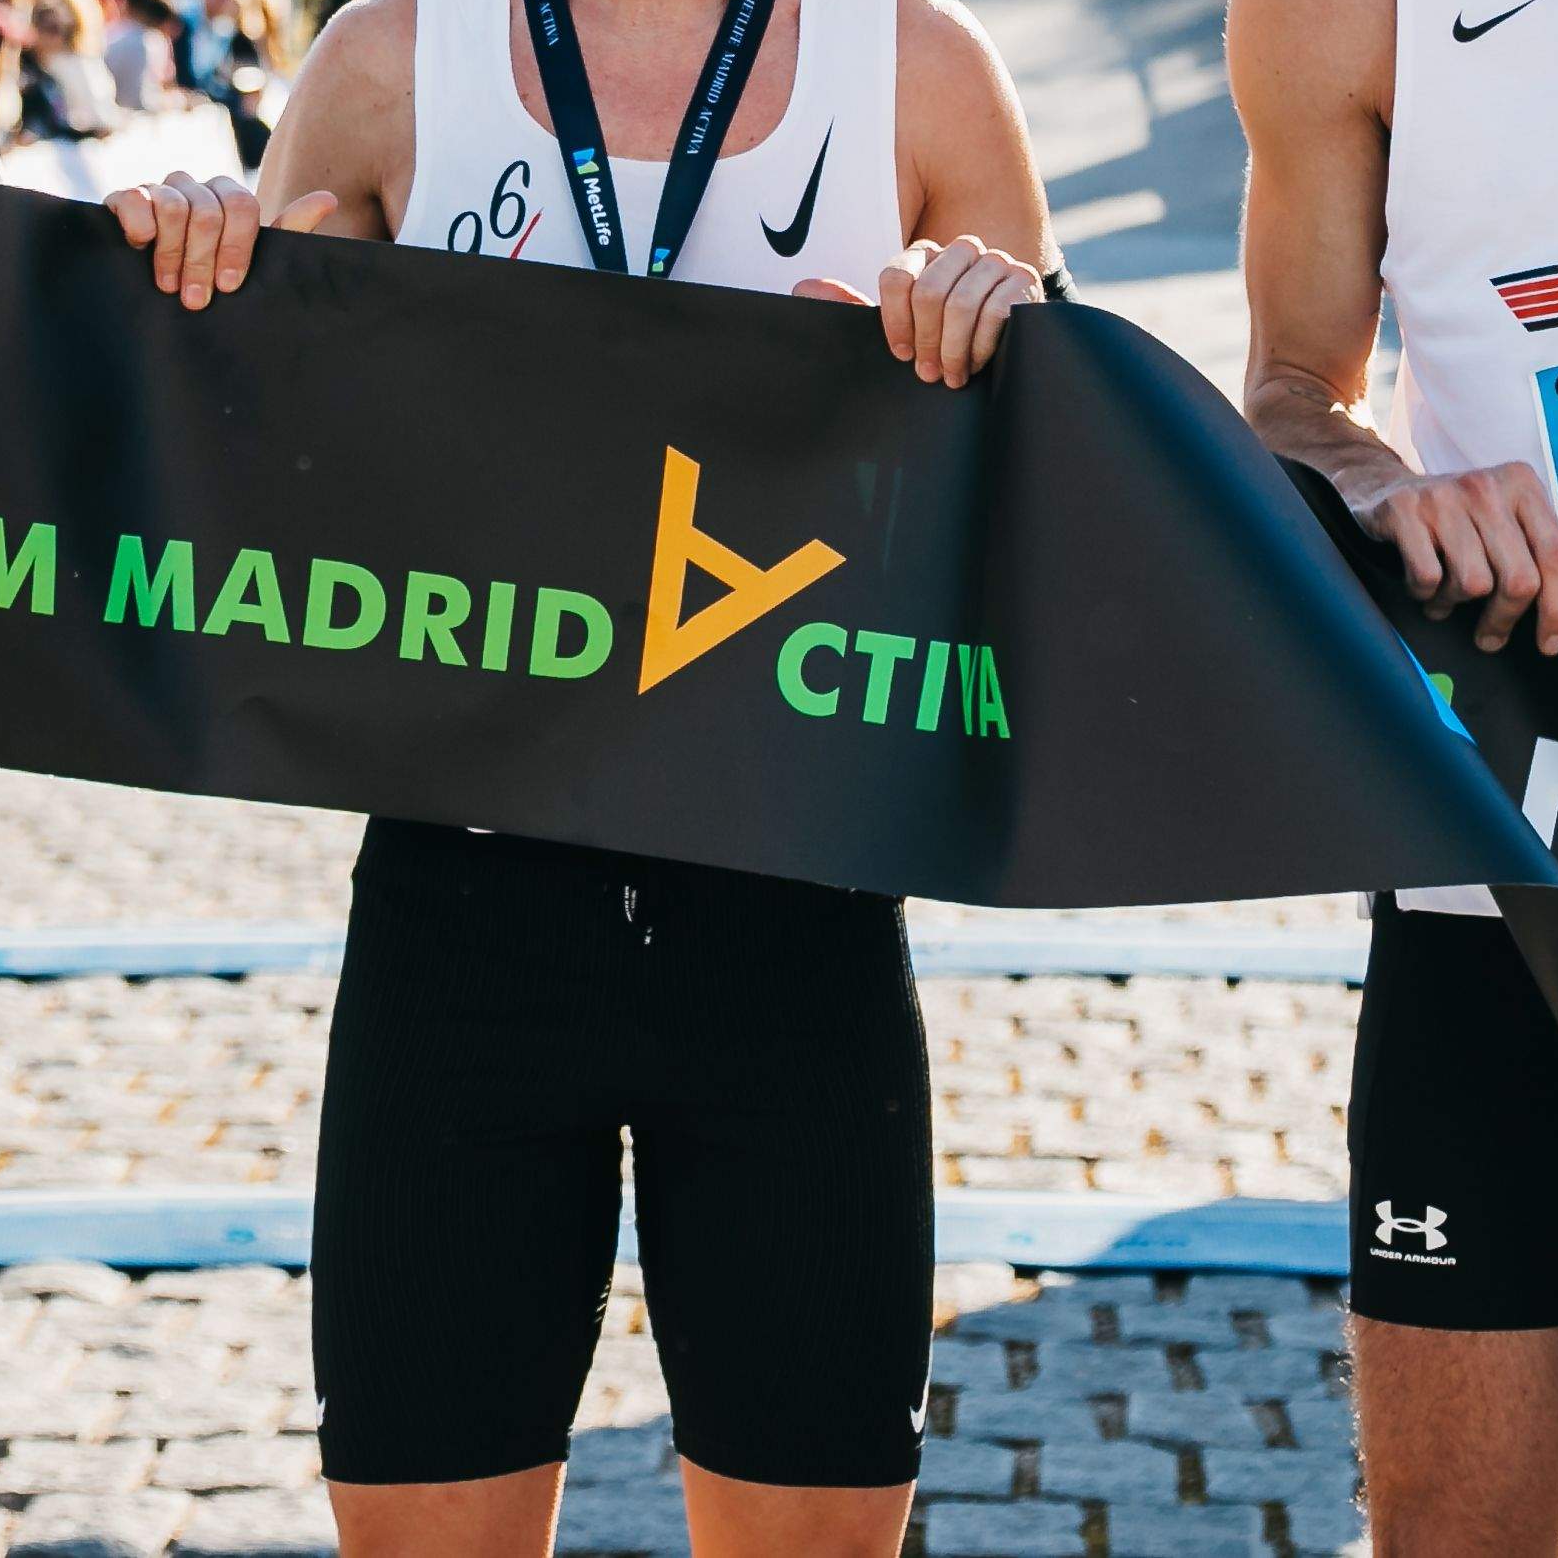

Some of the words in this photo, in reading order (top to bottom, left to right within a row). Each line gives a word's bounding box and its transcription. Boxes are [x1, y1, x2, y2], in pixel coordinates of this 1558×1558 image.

[539, 1, 560, 47] ACTIVA
[707, 51, 736, 104] MADRID
[686, 108, 713, 154] ACTIVA
[583, 176, 611, 247] MetLife
[102, 534, 615, 680] MADRID
[1370, 1247, 1403, 1260] UNDER
[1404, 1253, 1457, 1265] ARMOUR
